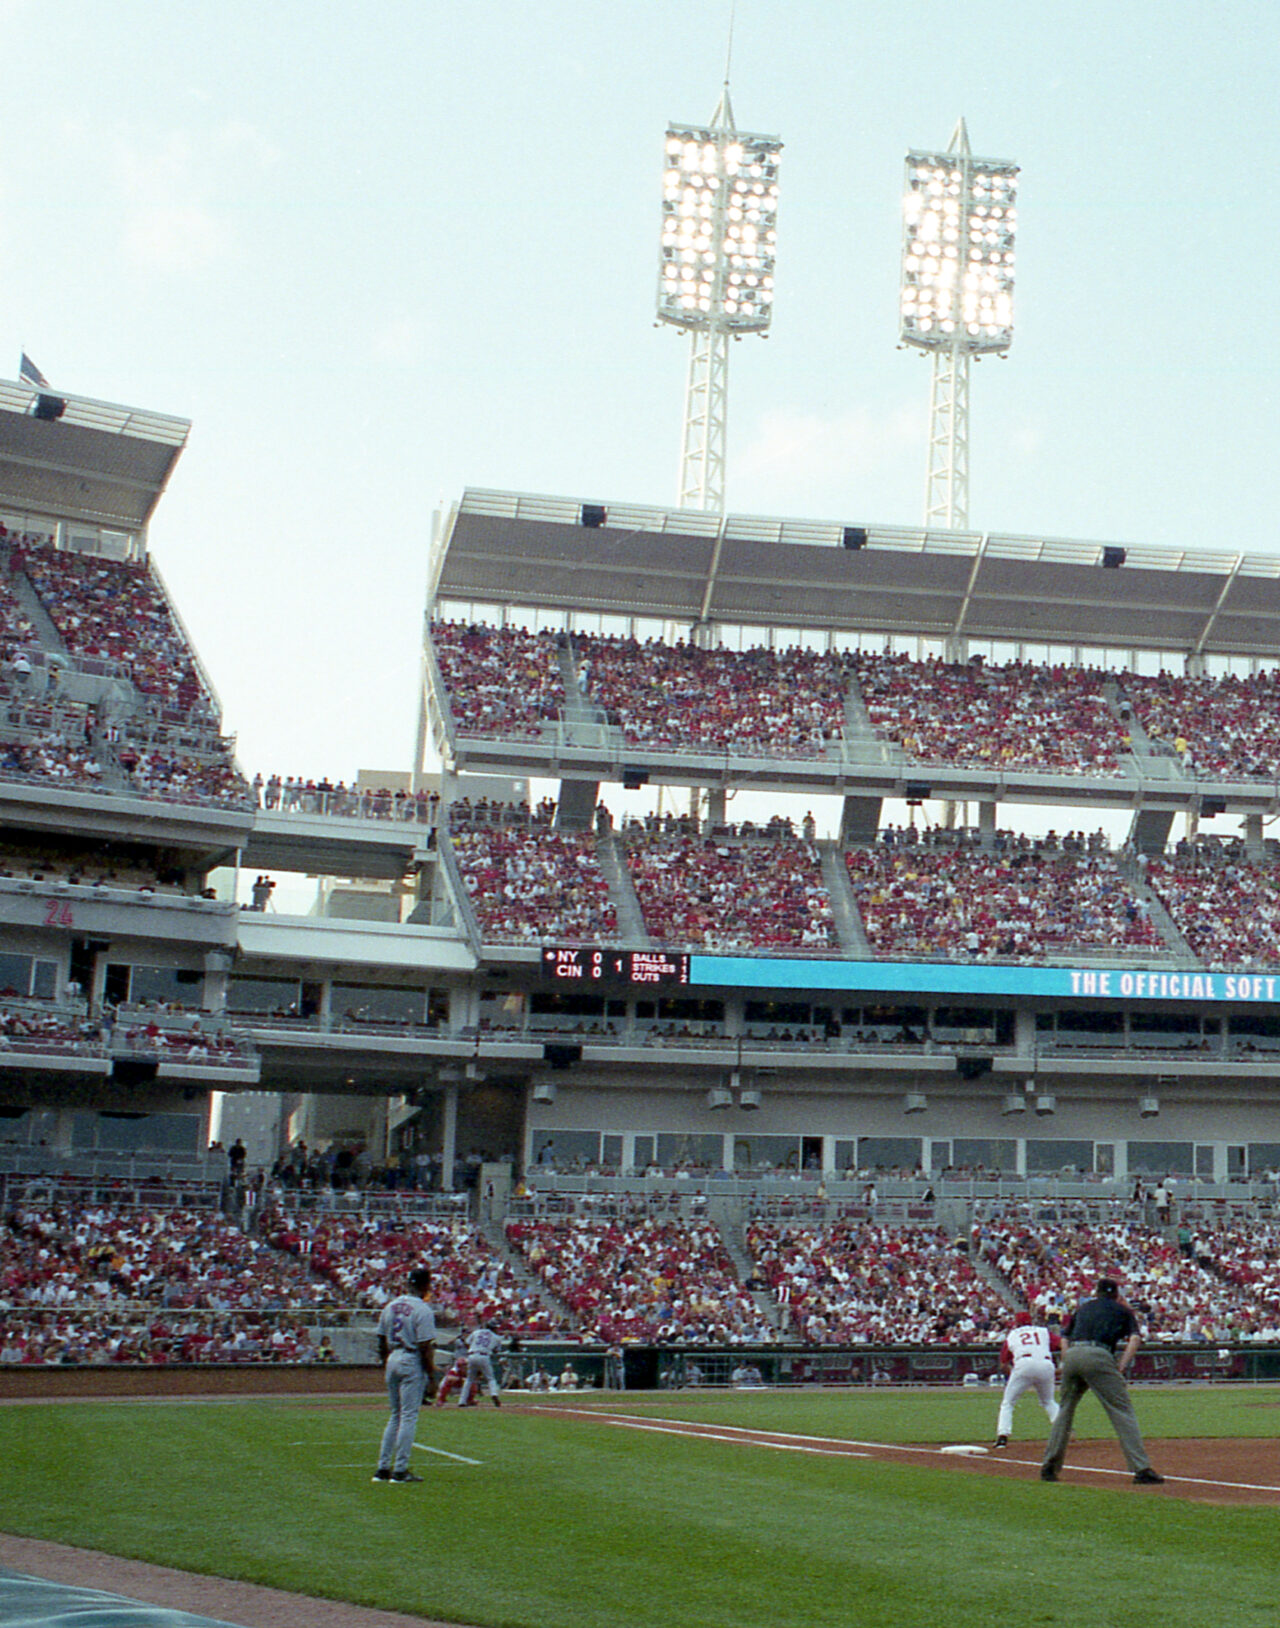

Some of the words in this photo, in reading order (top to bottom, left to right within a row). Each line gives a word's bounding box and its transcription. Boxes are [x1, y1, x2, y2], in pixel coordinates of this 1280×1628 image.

[558, 950, 578, 962] NY
[593, 952, 602, 964] 0
[632, 953, 666, 963] BALLS
[557, 964, 582, 977] CIN
[592, 966, 602, 978] 0
[615, 960, 622, 972] 1
[632, 963, 676, 973] STRIKES
[631, 973, 660, 982] OUTS
[1071, 972, 1111, 995] THE
[1120, 973, 1215, 998] OFFICIAL
[1225, 978, 1276, 1000] SOFT
[1019, 1331, 1042, 1346] 21
